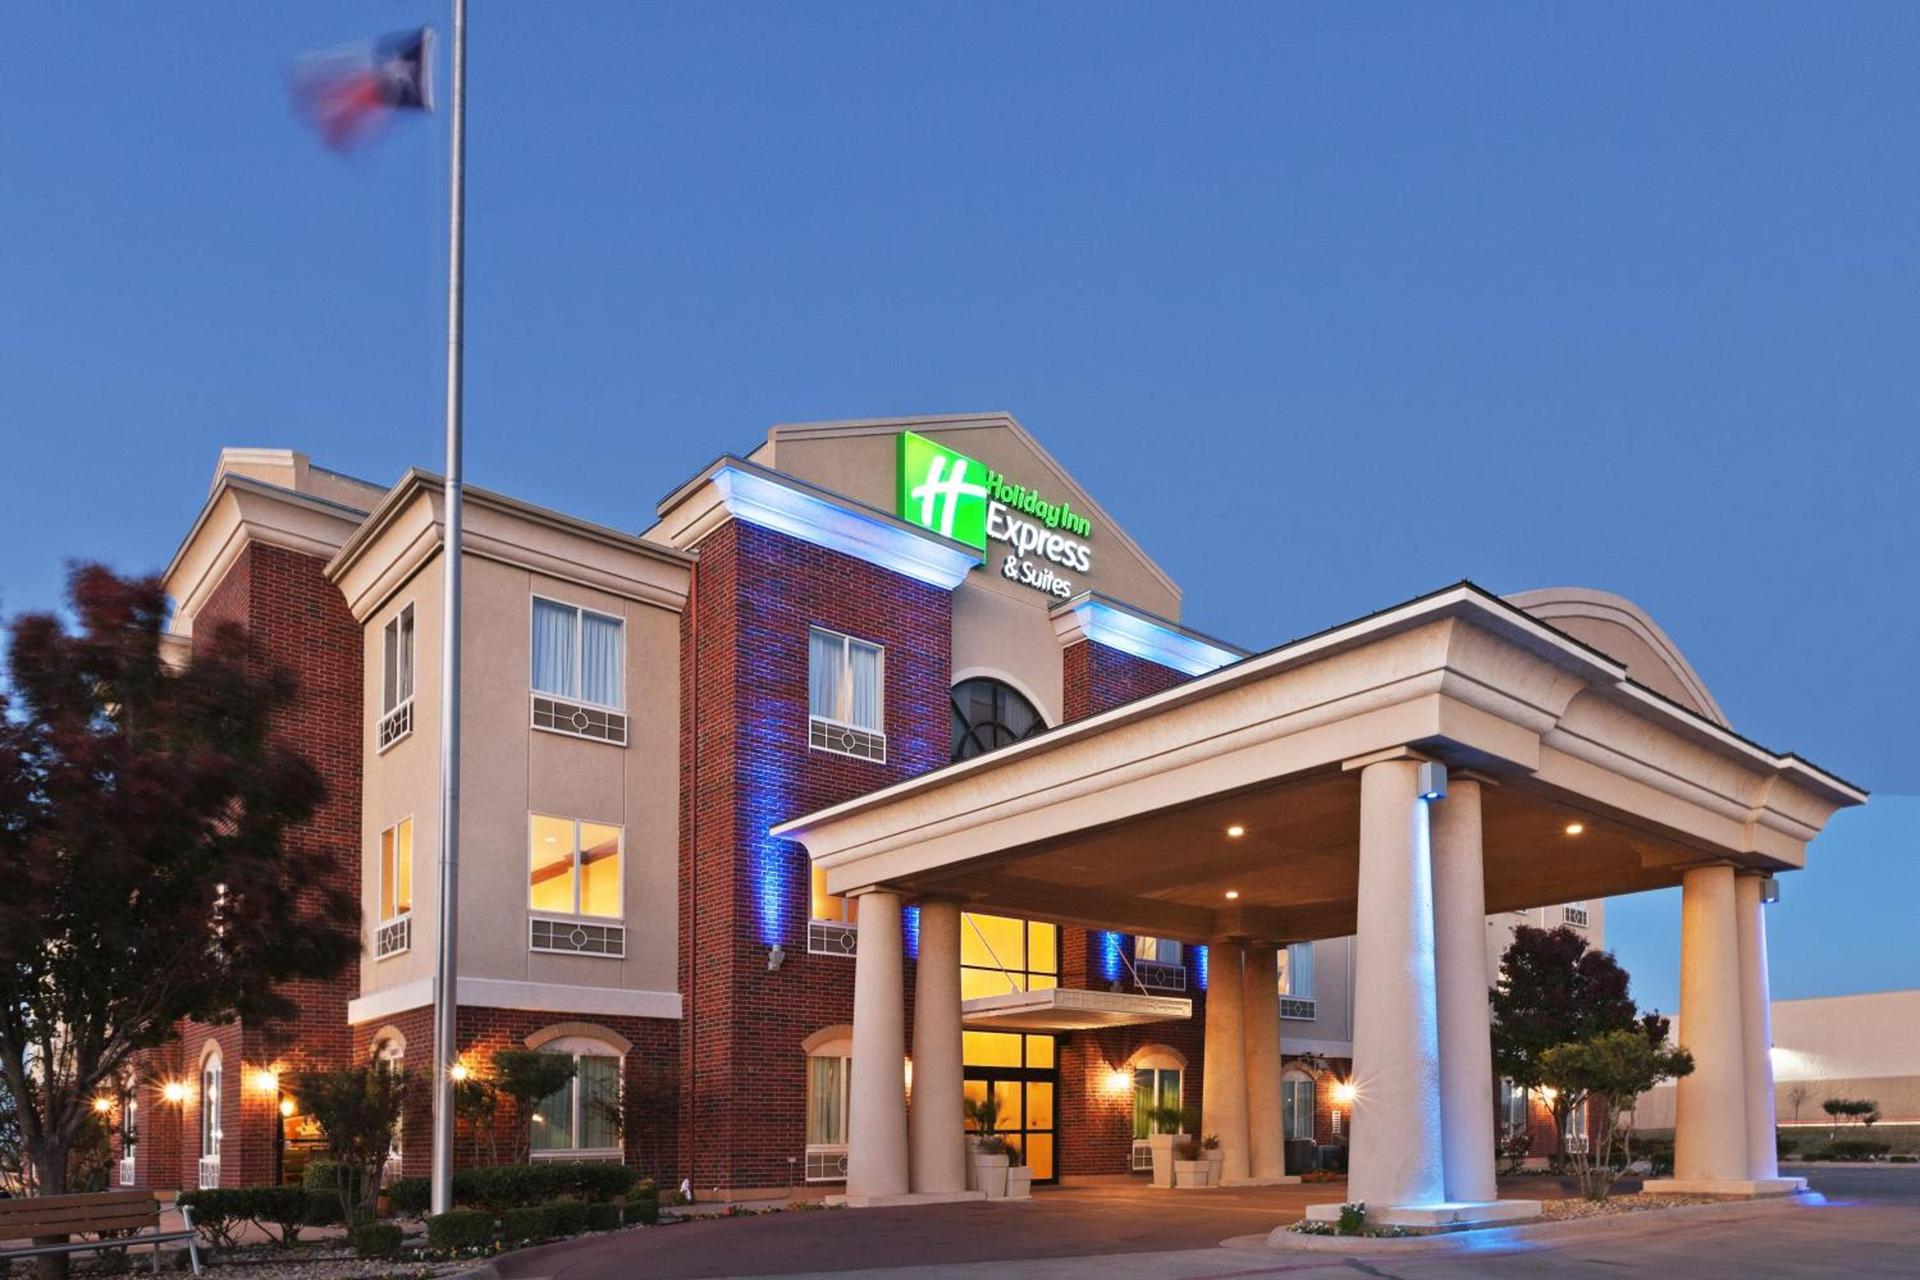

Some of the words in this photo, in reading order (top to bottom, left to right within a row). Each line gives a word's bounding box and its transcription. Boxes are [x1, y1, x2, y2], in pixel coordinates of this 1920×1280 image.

[911, 455, 987, 538] H
[987, 470, 1060, 527] Holiday
[1061, 502, 1090, 537] Inn
[986, 501, 1091, 572] Express
[1004, 555, 1018, 578] &
[1021, 561, 1071, 597] Suites
